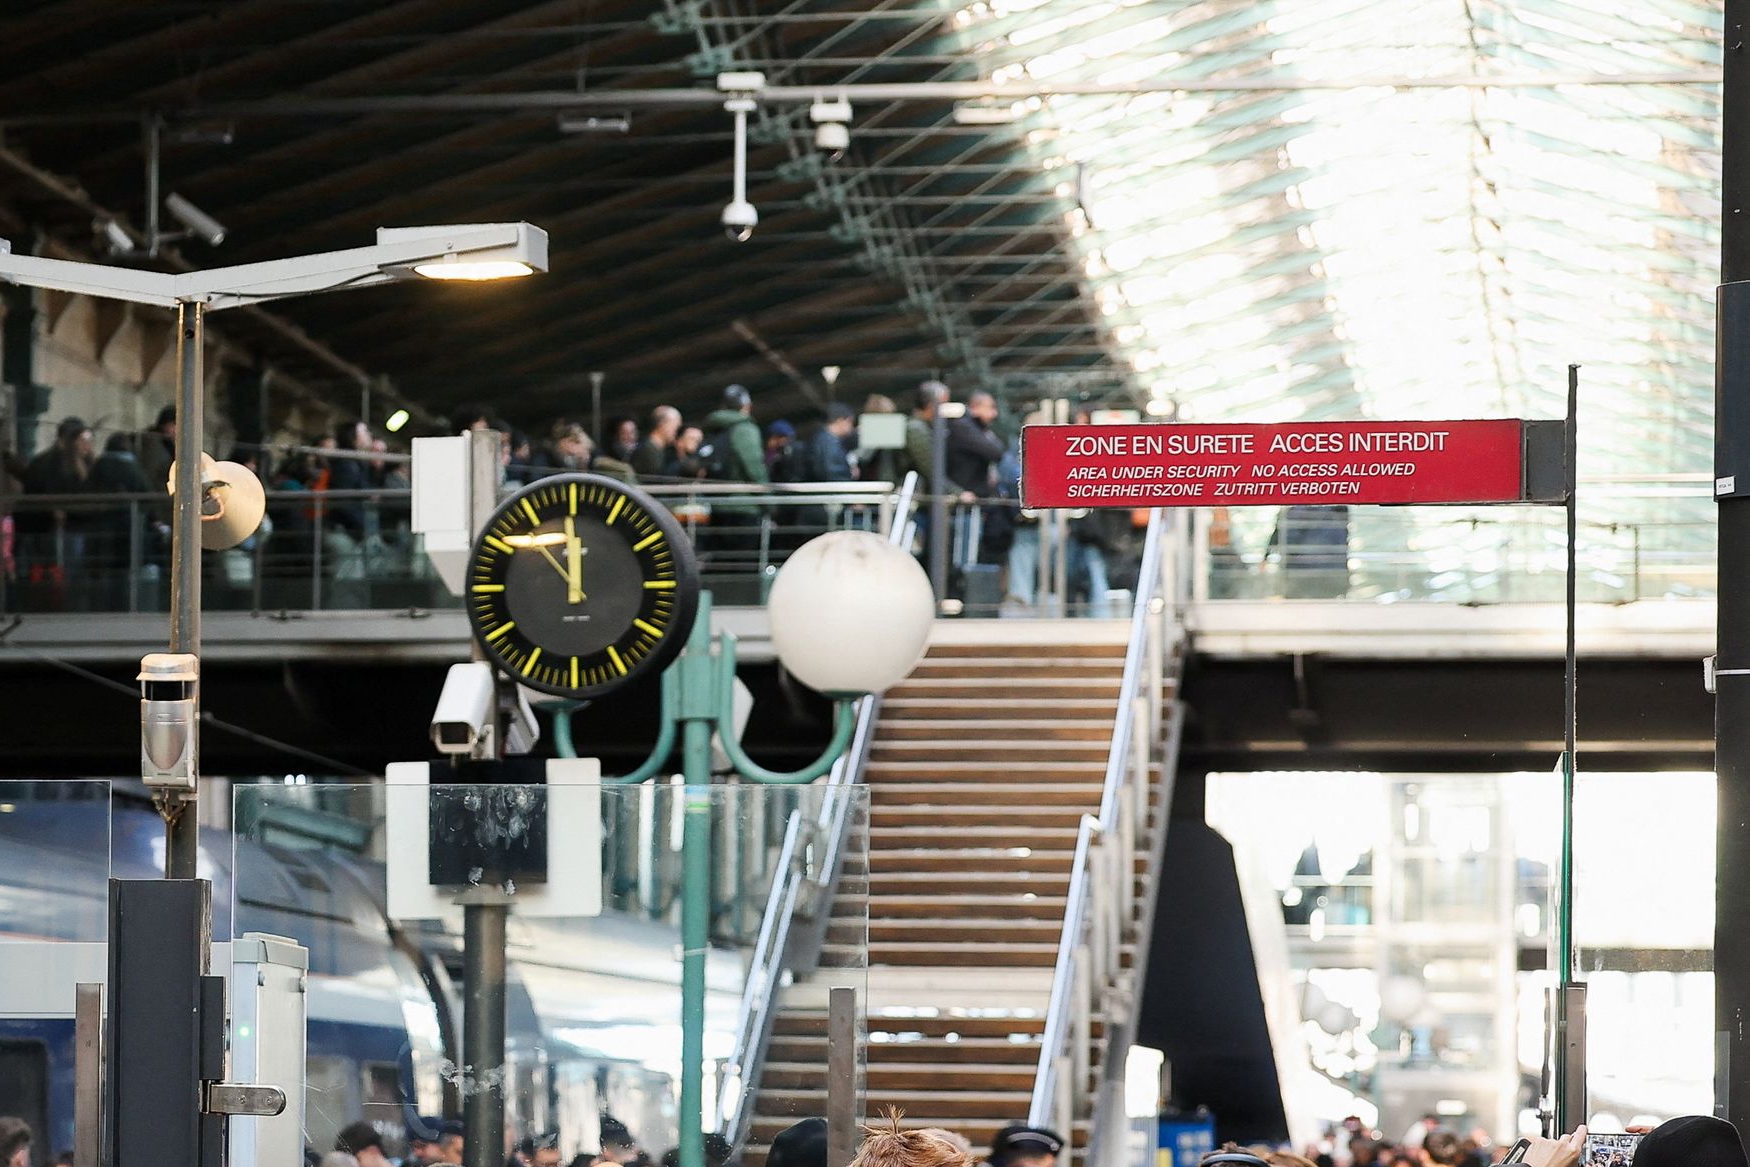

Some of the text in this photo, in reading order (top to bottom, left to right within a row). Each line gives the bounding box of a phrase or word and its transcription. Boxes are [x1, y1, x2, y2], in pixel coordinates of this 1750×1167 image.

[1065, 431, 1450, 456] ZONE EN SURETE ACCES INTERDIT
[1066, 463, 1416, 480] AREA UNDER SECURITY NO ACCESS ALLOWED
[1067, 481, 1361, 498] SICHERHEITSZONE ZUTRITT VERBOTEN
